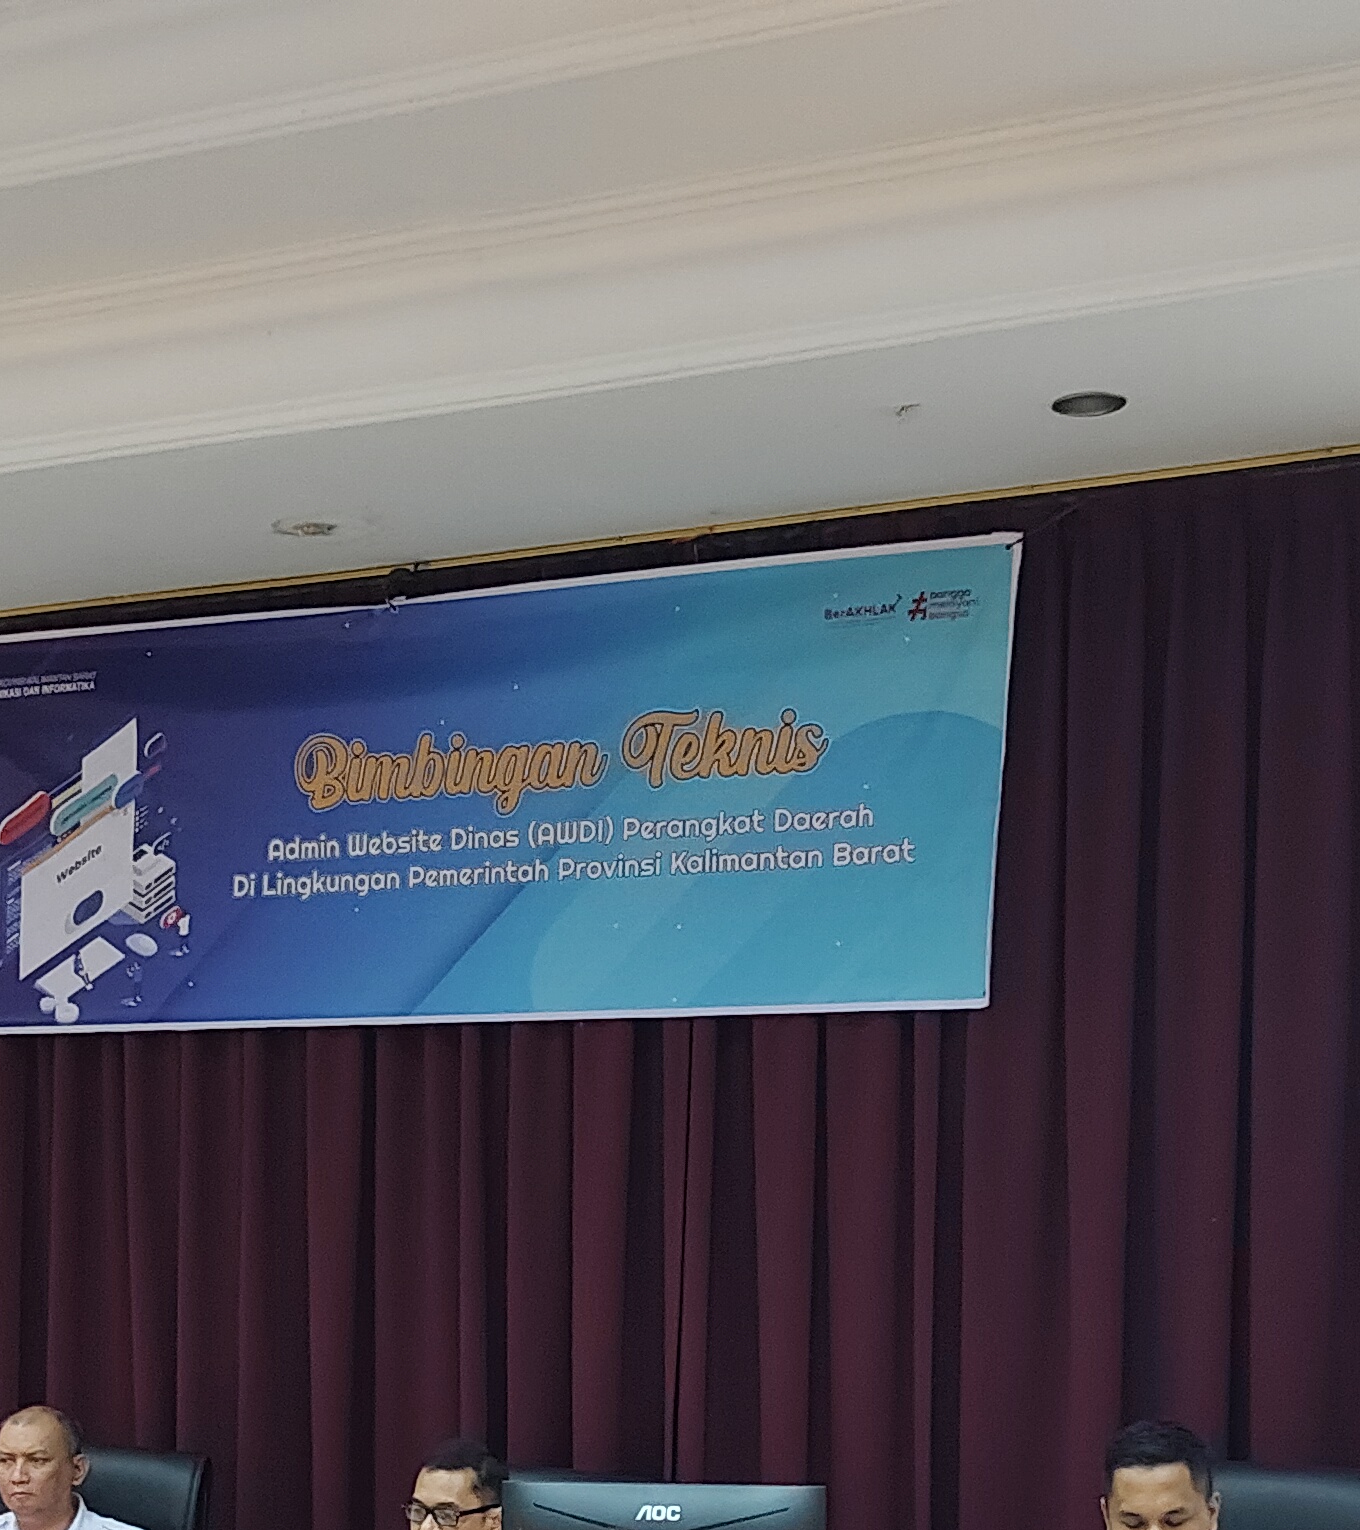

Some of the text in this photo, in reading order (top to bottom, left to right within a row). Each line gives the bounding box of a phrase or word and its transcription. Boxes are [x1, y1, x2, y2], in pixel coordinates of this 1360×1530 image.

[294, 707, 832, 817] Bimbingan Teknis
[267, 802, 875, 863] Admin Website Dinas (AWDI) Perangkat Daerah
[56, 844, 102, 884] Website
[232, 837, 917, 901] Di Lingkungan Pemerintah Provinsi Kalimantan Barat
[634, 1504, 682, 1522] AOC
